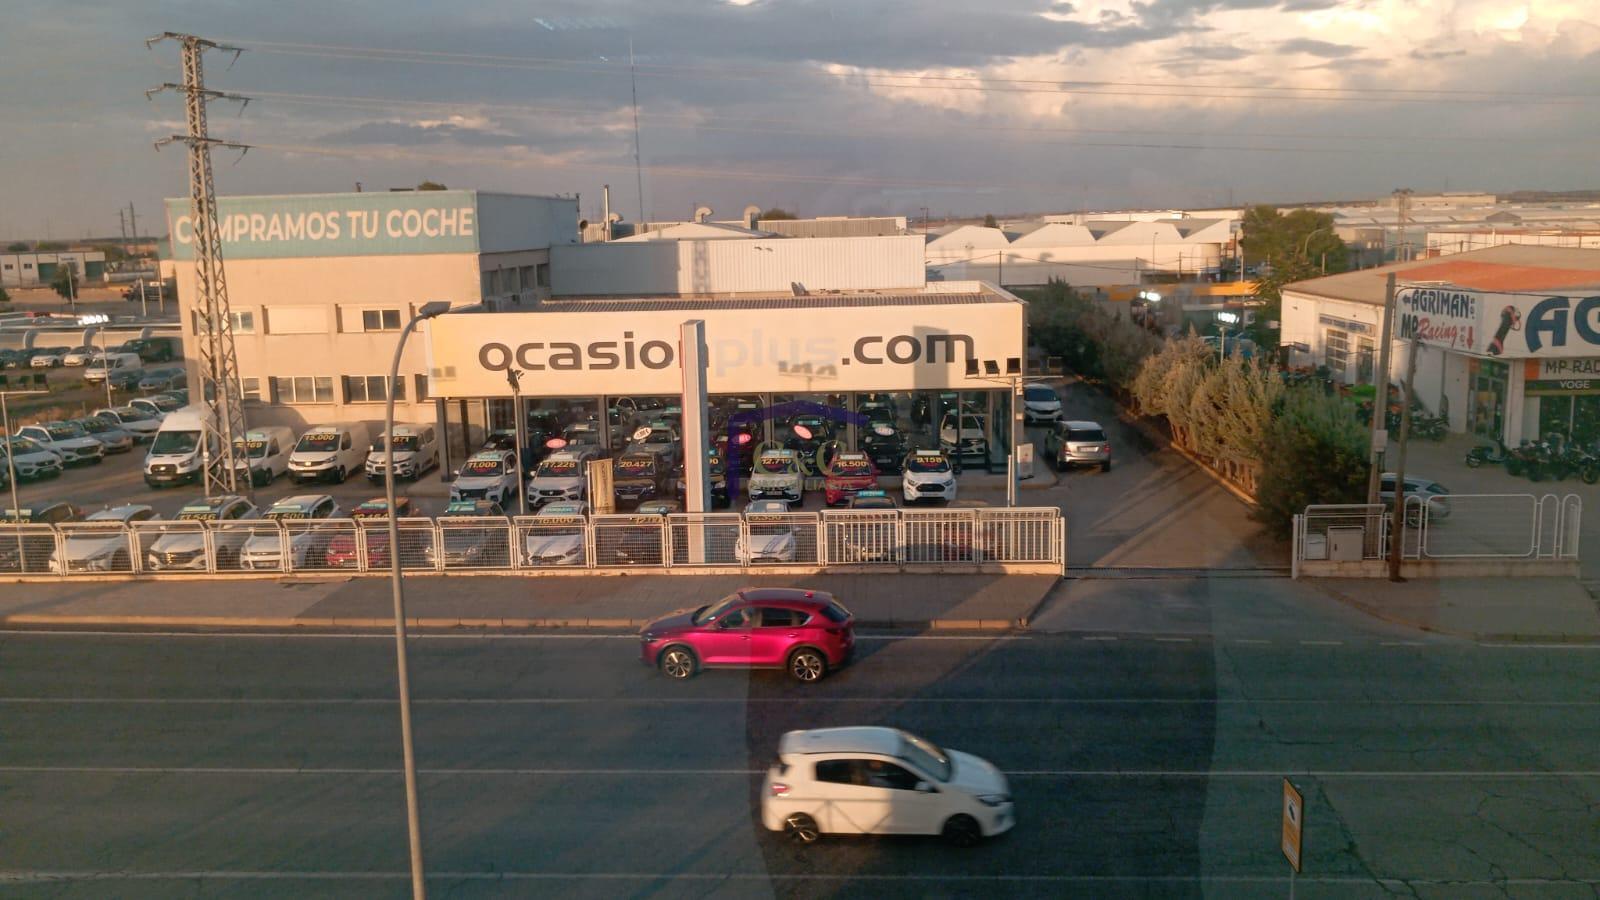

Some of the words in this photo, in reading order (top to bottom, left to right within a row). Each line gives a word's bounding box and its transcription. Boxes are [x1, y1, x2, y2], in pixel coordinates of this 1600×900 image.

[175, 211, 340, 243] CMPRAMOS
[346, 210, 379, 239] TU
[386, 207, 474, 238] COCHE
[1411, 289, 1470, 319] AGRIMAN
[1418, 317, 1458, 348] Racing
[1560, 381, 1591, 389] YOGE
